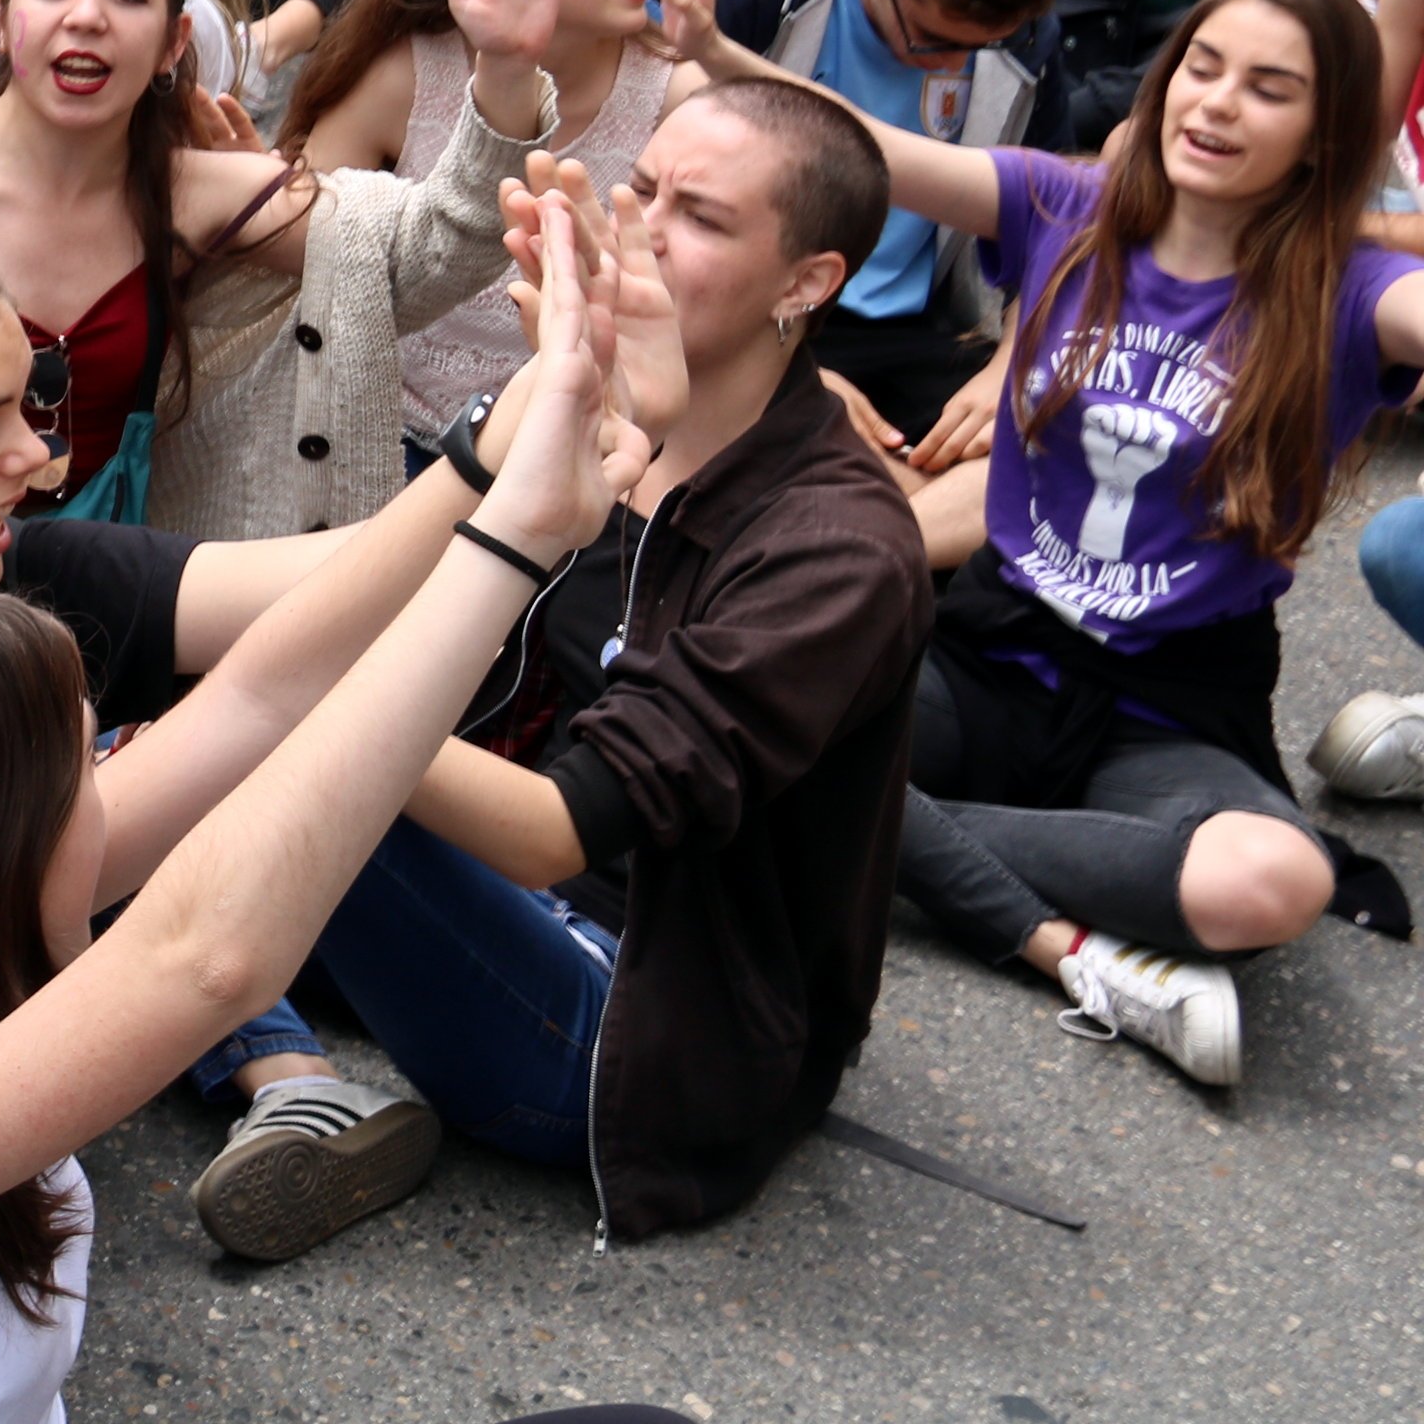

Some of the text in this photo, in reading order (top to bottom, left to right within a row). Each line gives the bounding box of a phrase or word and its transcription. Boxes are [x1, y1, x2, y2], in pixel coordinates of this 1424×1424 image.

[1148, 360, 1232, 437] LIBRES
[1093, 560, 1136, 596] POR
[1141, 562, 1170, 596] LA
